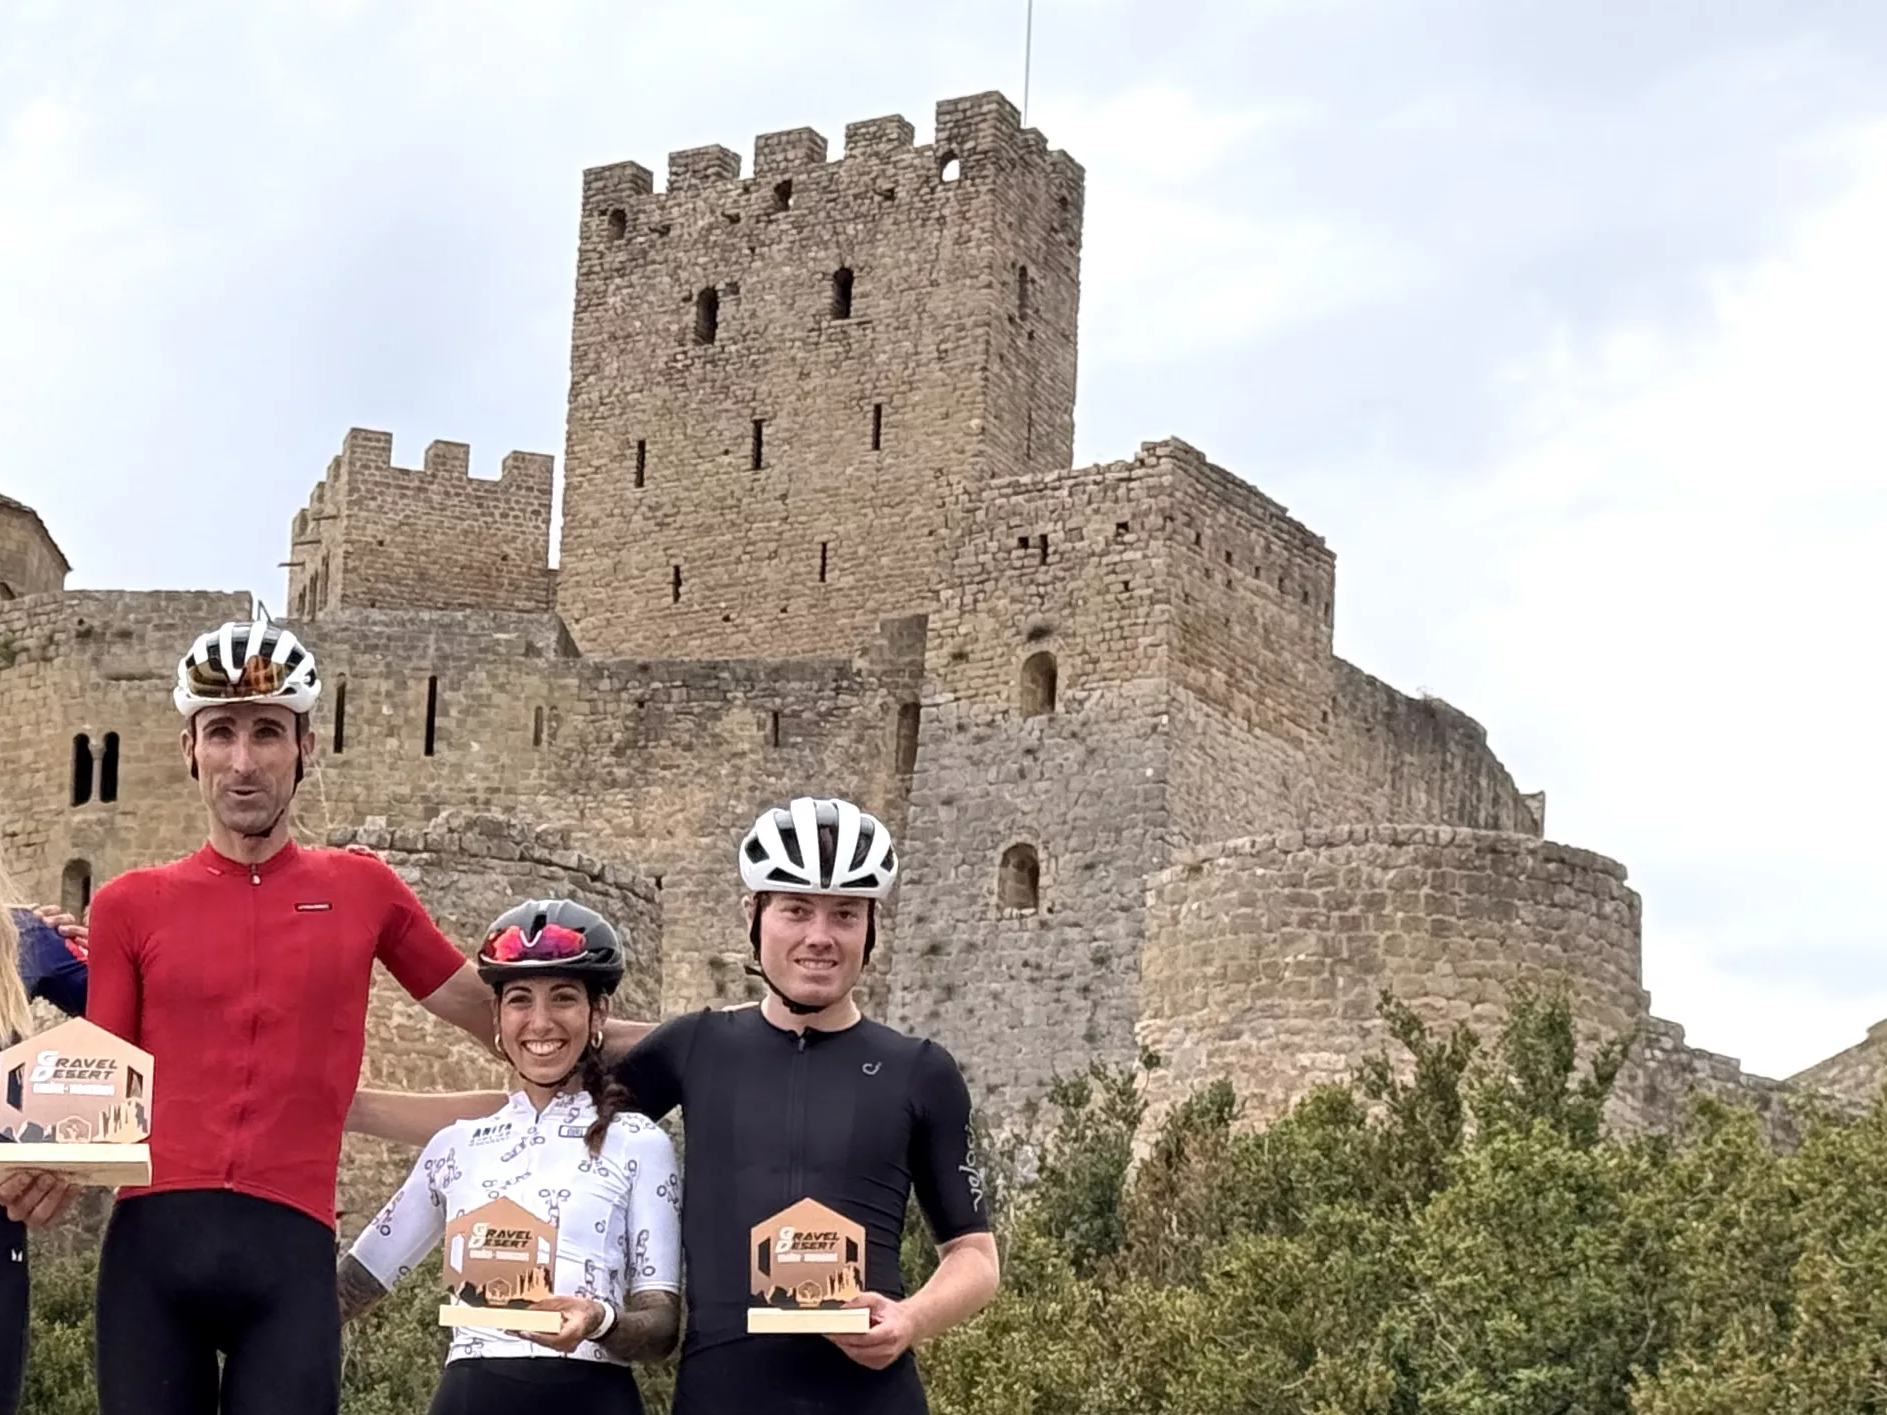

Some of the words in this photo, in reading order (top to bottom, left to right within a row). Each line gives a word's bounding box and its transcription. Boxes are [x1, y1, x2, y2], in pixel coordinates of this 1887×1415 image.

[37, 1050, 119, 1070] GRAVEL
[29, 1066, 115, 1082] DESERT
[472, 1222, 533, 1240] GRAVEL
[779, 1226, 841, 1241] GRAVEL
